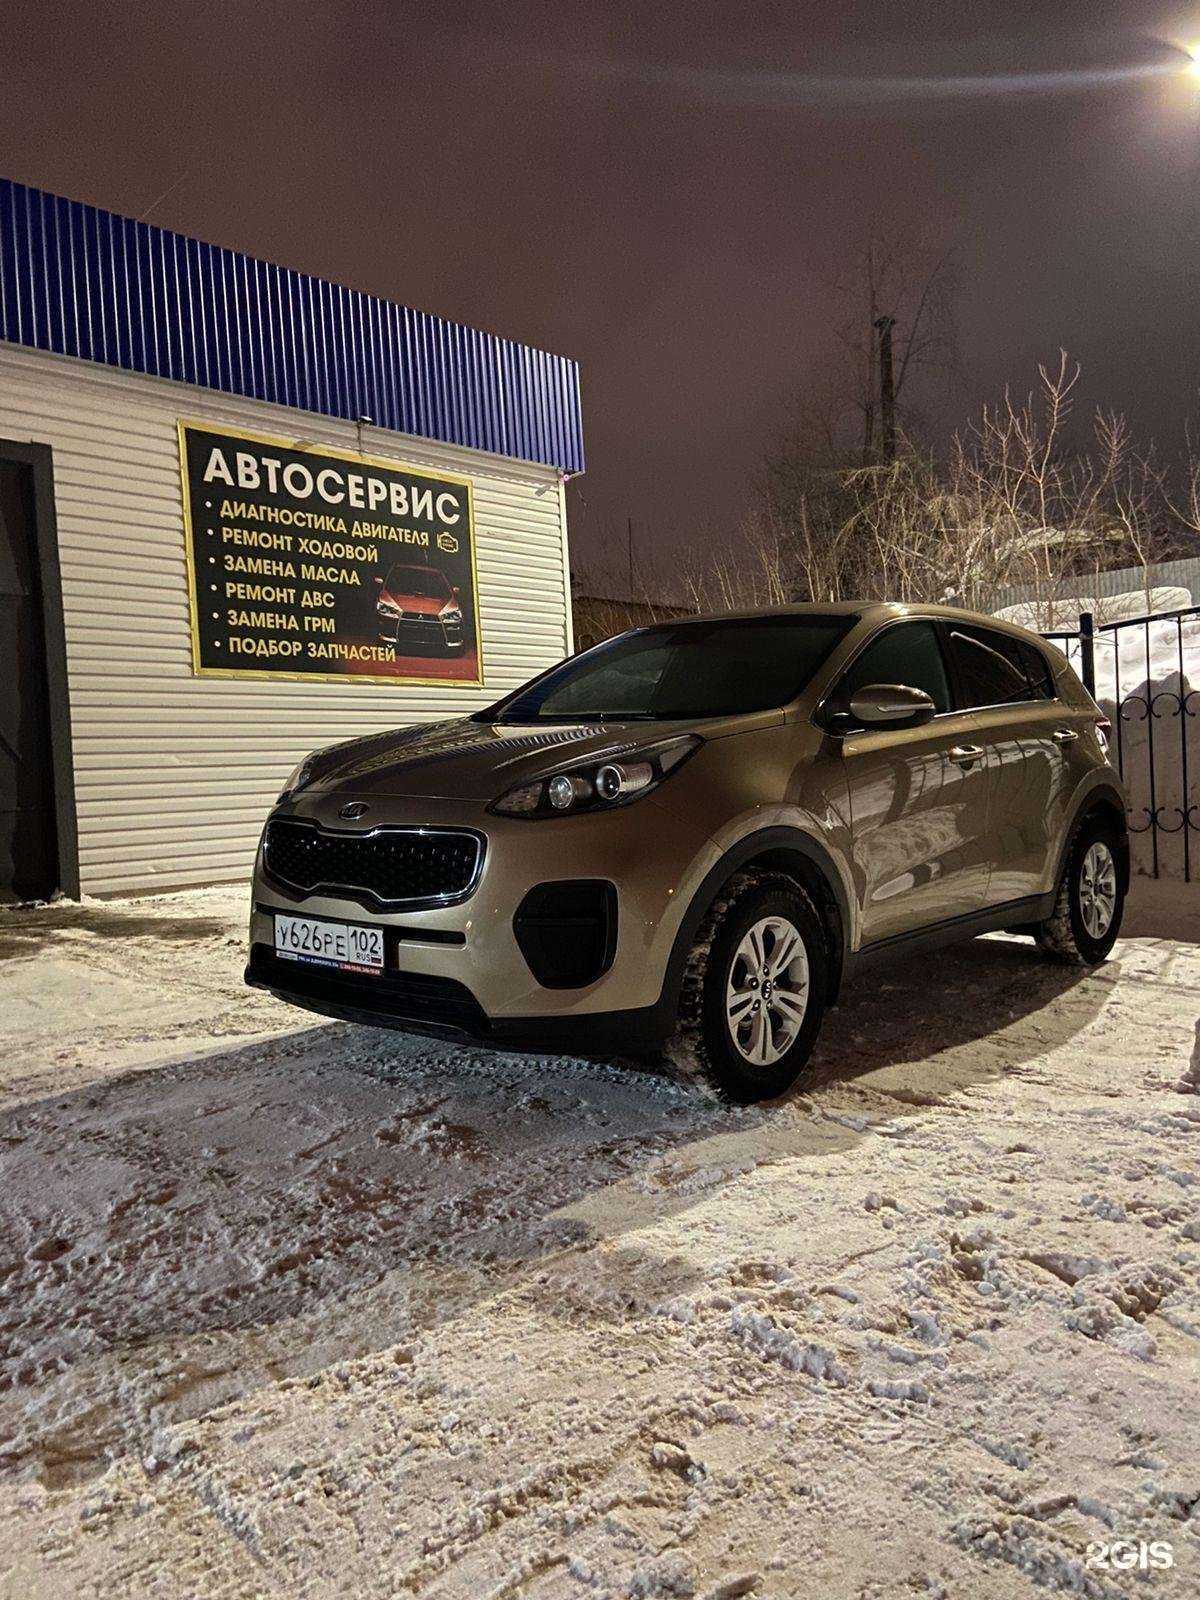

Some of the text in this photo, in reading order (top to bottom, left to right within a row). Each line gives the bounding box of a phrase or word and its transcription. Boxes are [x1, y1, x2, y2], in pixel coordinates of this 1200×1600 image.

[203, 448, 461, 524] АВТОСЕРВИС
[220, 500, 429, 546] ДИАГНОСТИКА ДВИГАТЕЛЯ
[222, 526, 378, 563] РЕМОНТ ХОДОВОЙ
[224, 555, 361, 586] ЗАМЕНА МАСЛА
[226, 582, 335, 608] РЕМОНТ ДВС
[228, 610, 336, 634] ЗАМЕНА ГРМ
[229, 637, 396, 662] ПОДБОР ЗАПЧАСТЕЙ
[350, 929, 379, 954] 102
[356, 952, 371, 962] RUS
